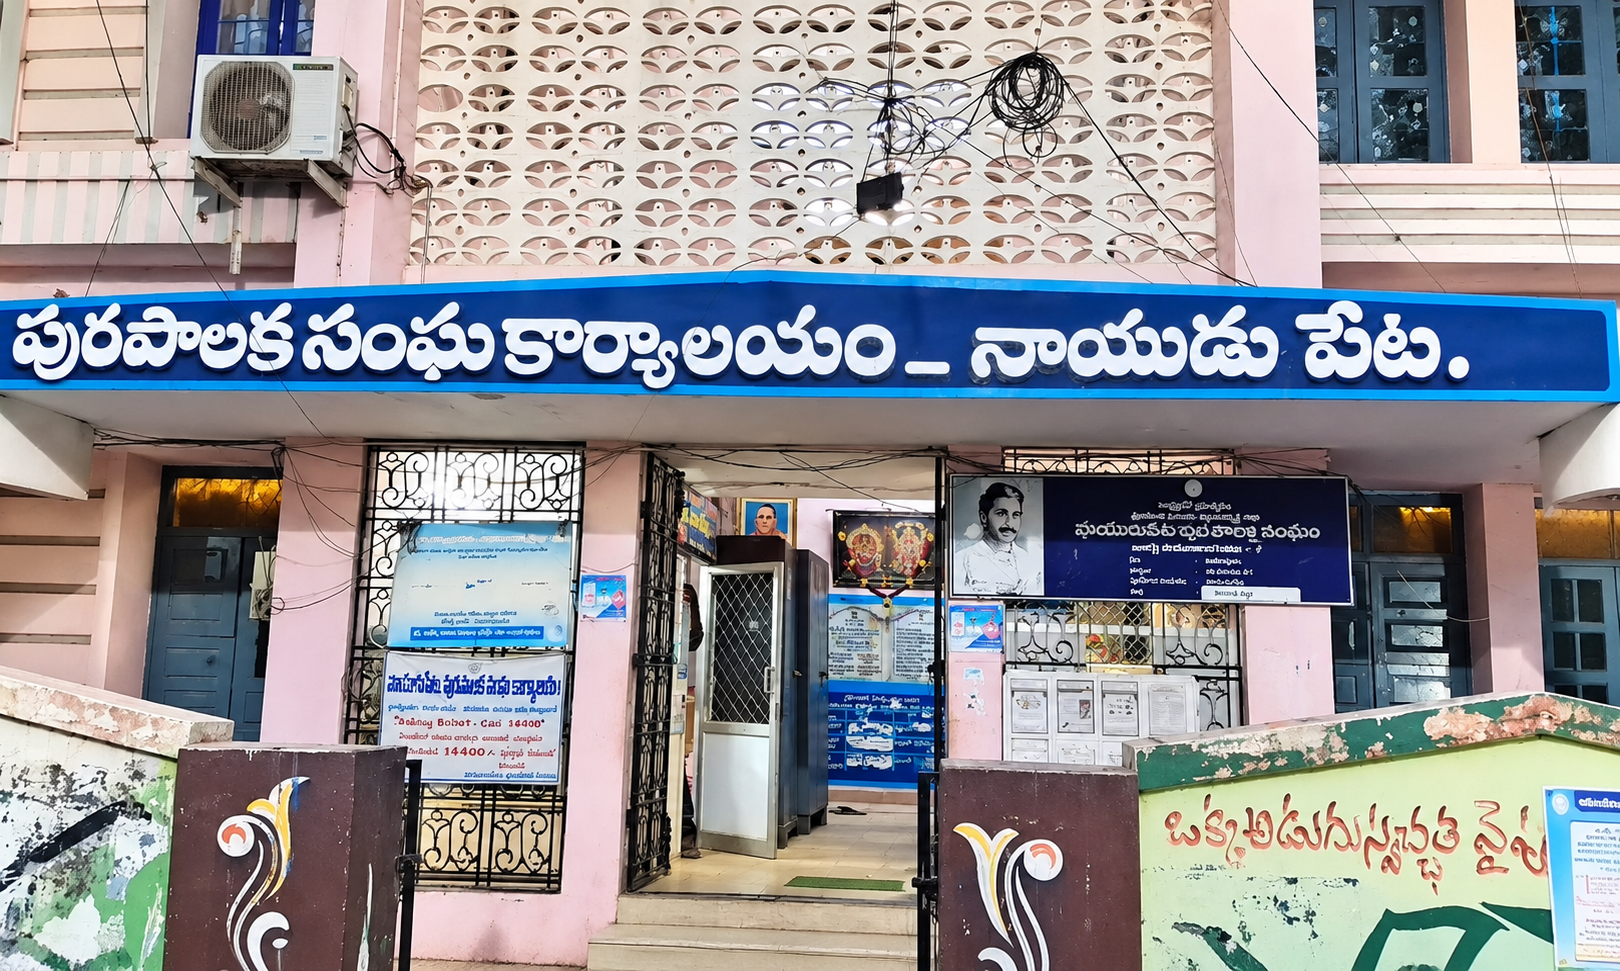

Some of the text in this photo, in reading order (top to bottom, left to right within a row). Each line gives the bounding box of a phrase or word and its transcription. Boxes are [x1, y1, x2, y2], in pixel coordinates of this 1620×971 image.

[13, 303, 294, 380] పురపాలక
[303, 302, 495, 382] సంఘ
[971, 305, 1279, 378] నాయుడు
